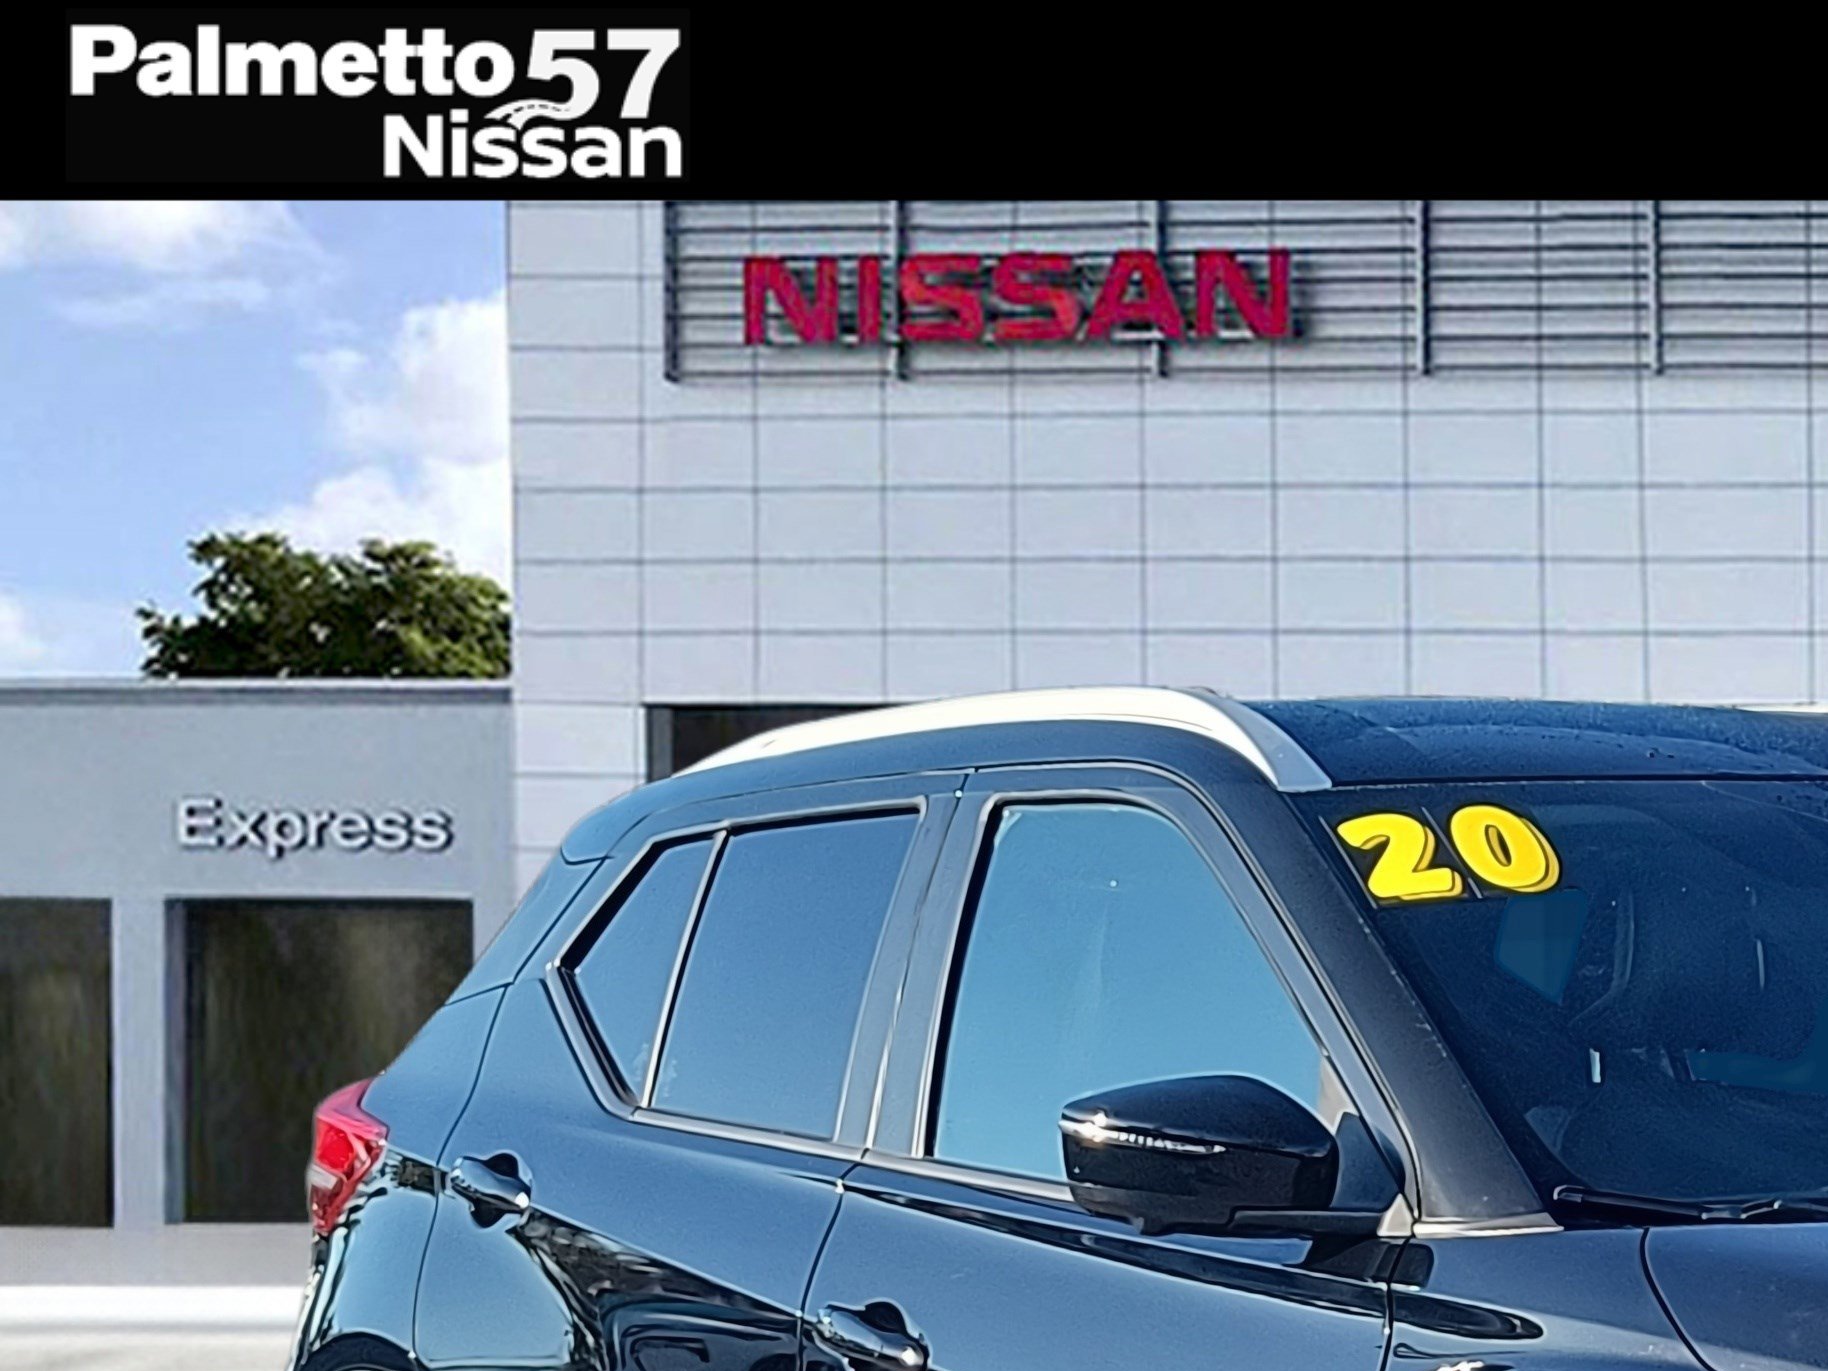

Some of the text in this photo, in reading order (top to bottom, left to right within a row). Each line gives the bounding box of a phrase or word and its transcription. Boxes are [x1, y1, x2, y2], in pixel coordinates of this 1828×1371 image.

[743, 247, 1290, 346] NISSAN
[177, 796, 453, 860] Express
[1336, 804, 1560, 900] 20
